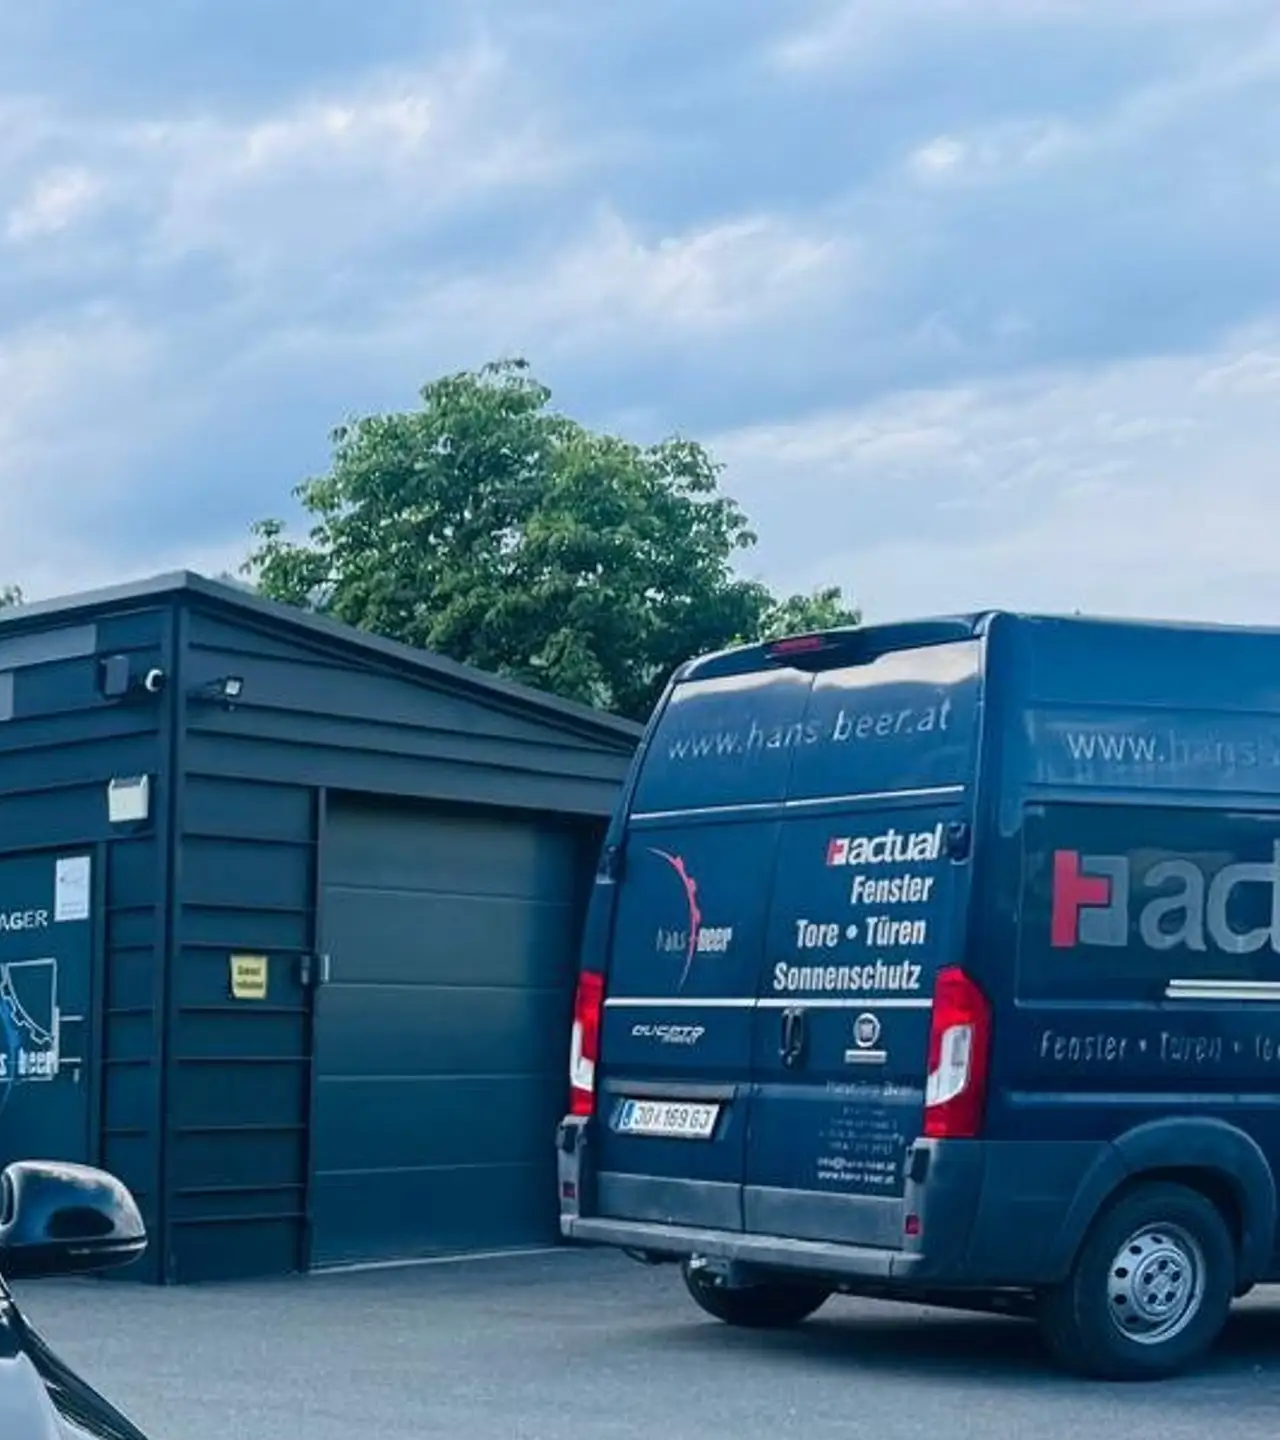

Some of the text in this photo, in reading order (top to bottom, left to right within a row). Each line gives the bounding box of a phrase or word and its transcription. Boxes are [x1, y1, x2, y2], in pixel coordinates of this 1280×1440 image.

[848, 822, 943, 866] actual
[850, 873, 934, 905] Fenster
[1140, 838, 1280, 955] ac
[795, 914, 927, 948] Tore Türen
[773, 957, 923, 991] Sonnenschutz
